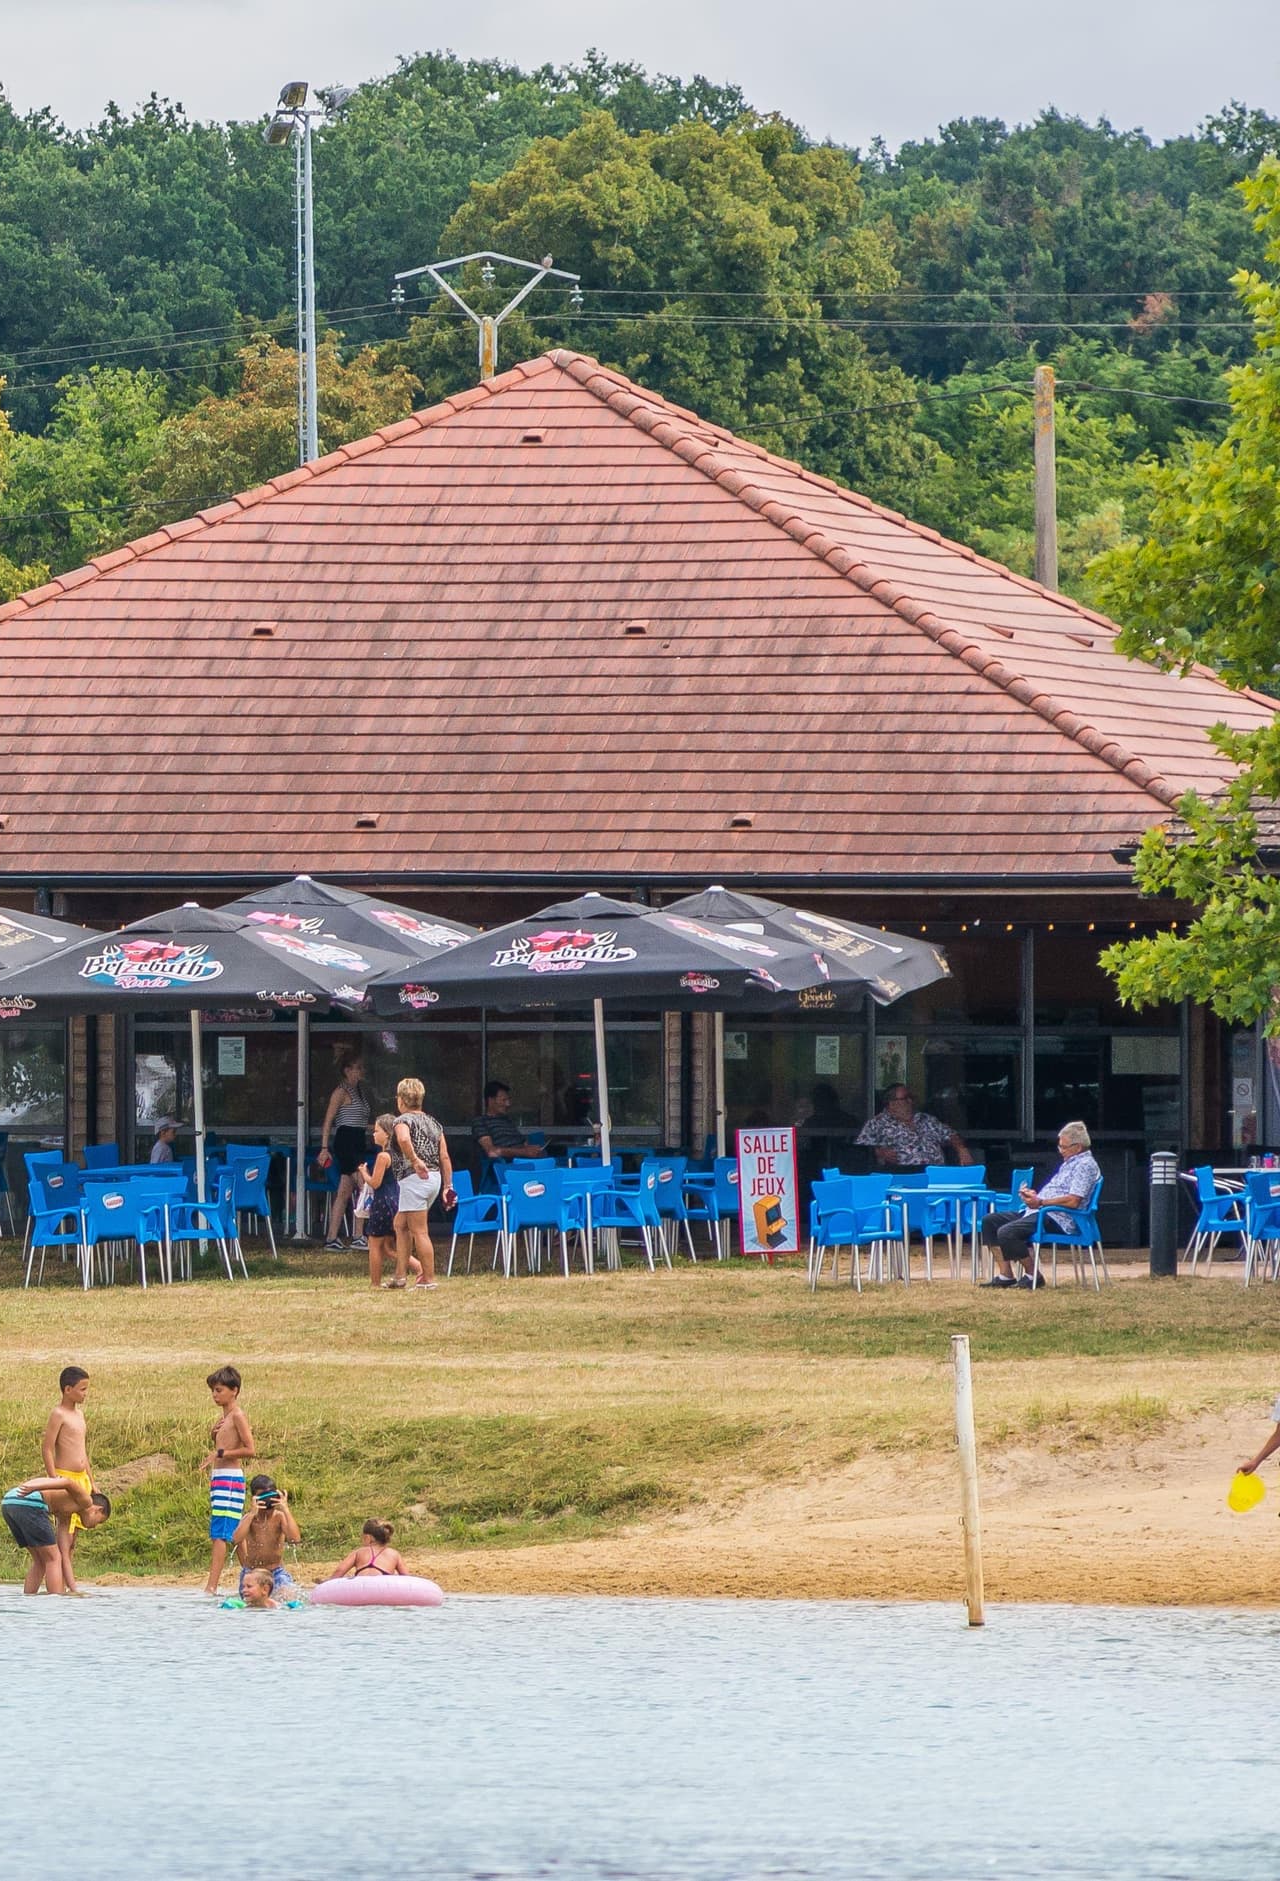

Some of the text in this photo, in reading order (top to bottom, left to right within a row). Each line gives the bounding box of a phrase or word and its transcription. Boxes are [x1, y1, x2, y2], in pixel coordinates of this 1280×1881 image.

[743, 1134, 789, 1154] SALLE
[757, 1156, 776, 1175] DE
[750, 1177, 786, 1197] JEUX
